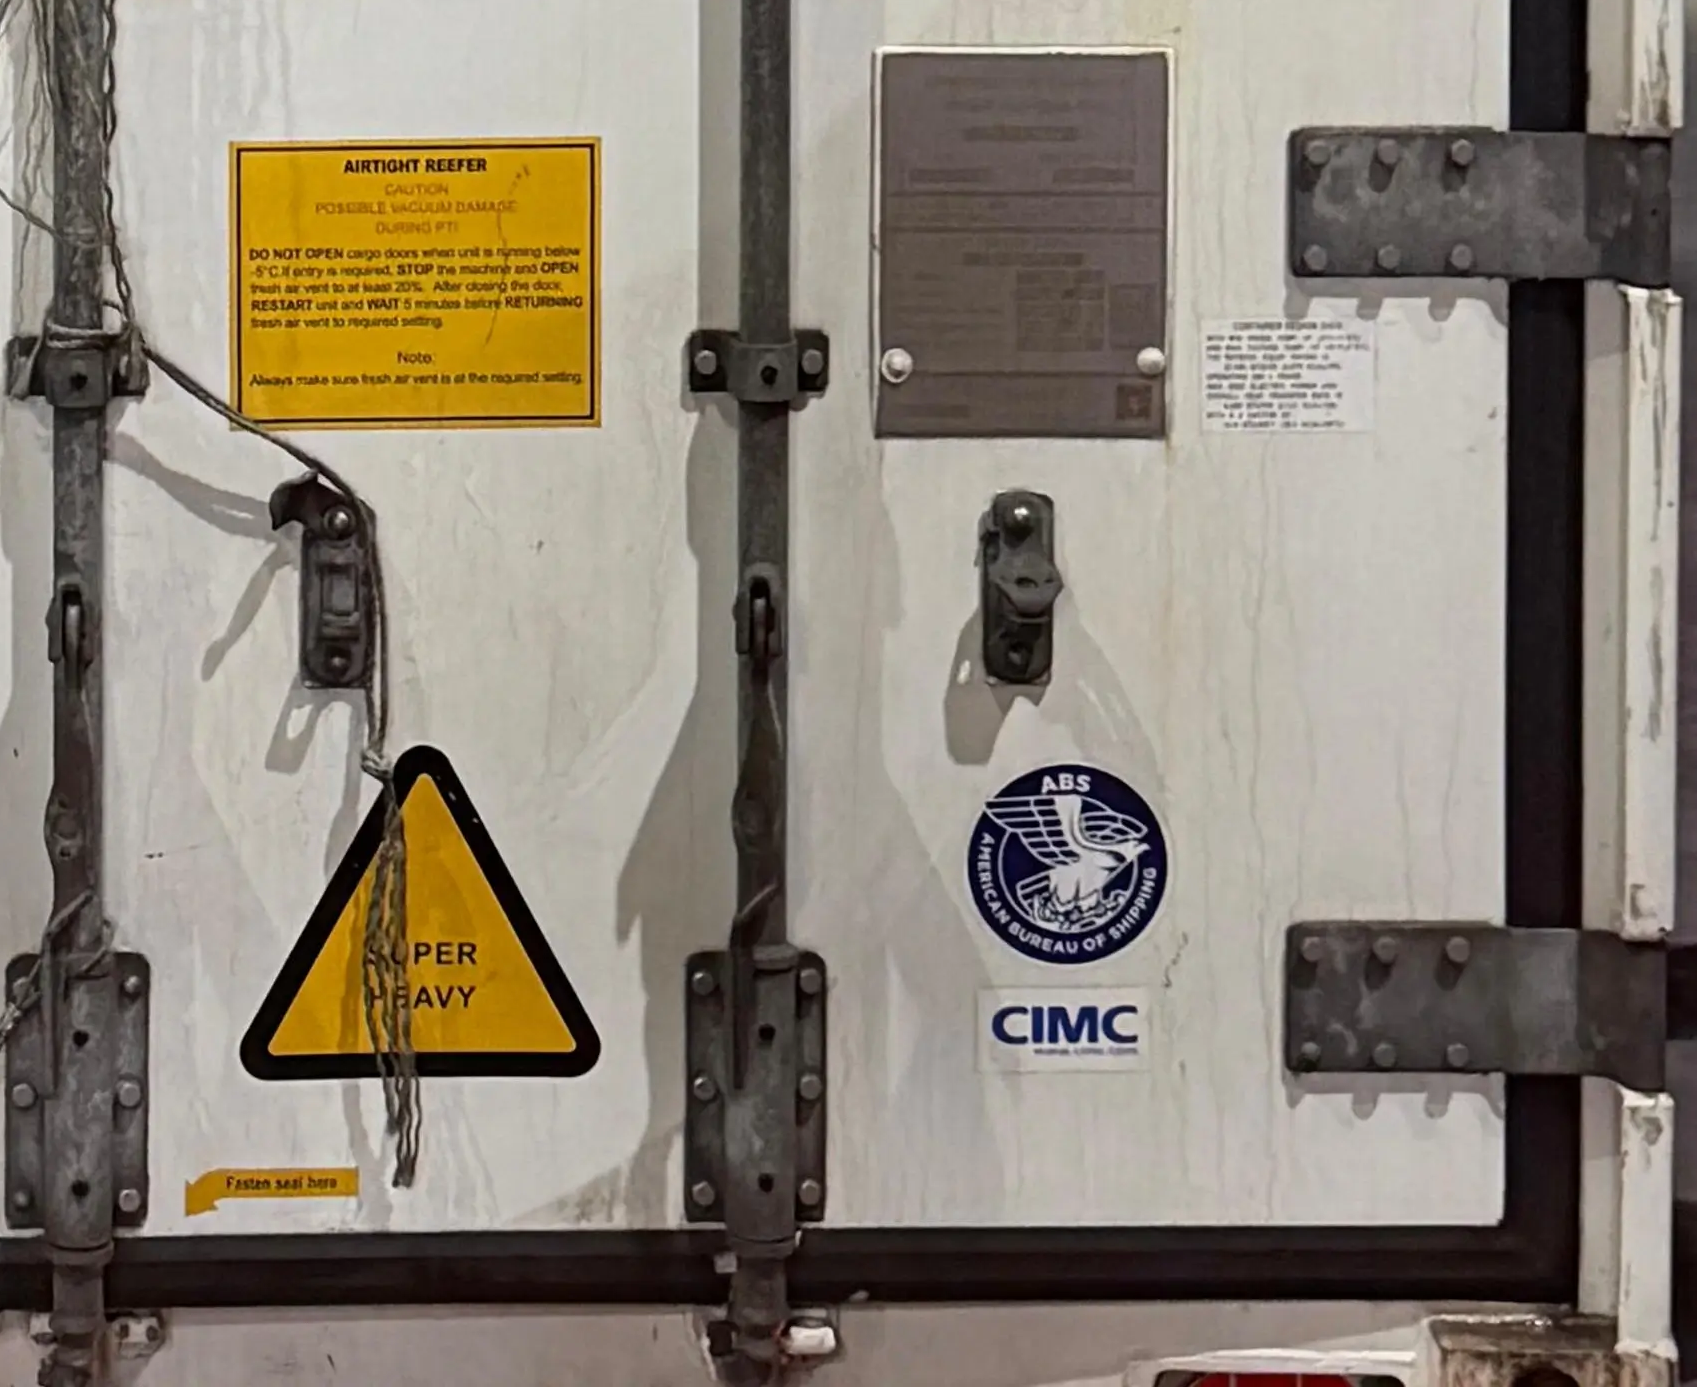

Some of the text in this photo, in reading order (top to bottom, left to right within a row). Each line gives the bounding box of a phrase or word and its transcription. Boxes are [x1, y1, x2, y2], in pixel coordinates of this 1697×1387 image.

[343, 157, 487, 174] AIRTIGHT REEFER
[384, 182, 449, 196] CAUTION
[315, 201, 387, 215] POSSIBLE
[455, 199, 519, 213] DAMAGE
[375, 220, 432, 235] DURING
[249, 248, 270, 261] DO
[273, 248, 302, 261] NOT
[305, 247, 344, 260] OPEN
[396, 263, 434, 276] STOP
[540, 261, 579, 274] OPEN
[251, 298, 313, 312] RESTART
[367, 298, 400, 311] WAIT
[505, 296, 584, 309] RETURNING
[1041, 772, 1092, 794] ABS
[975, 831, 1159, 955] AMERICAN BUREAU OF SHIPPING
[991, 1005, 1138, 1045] CIMC
[226, 1175, 338, 1191] Fasten seal here
